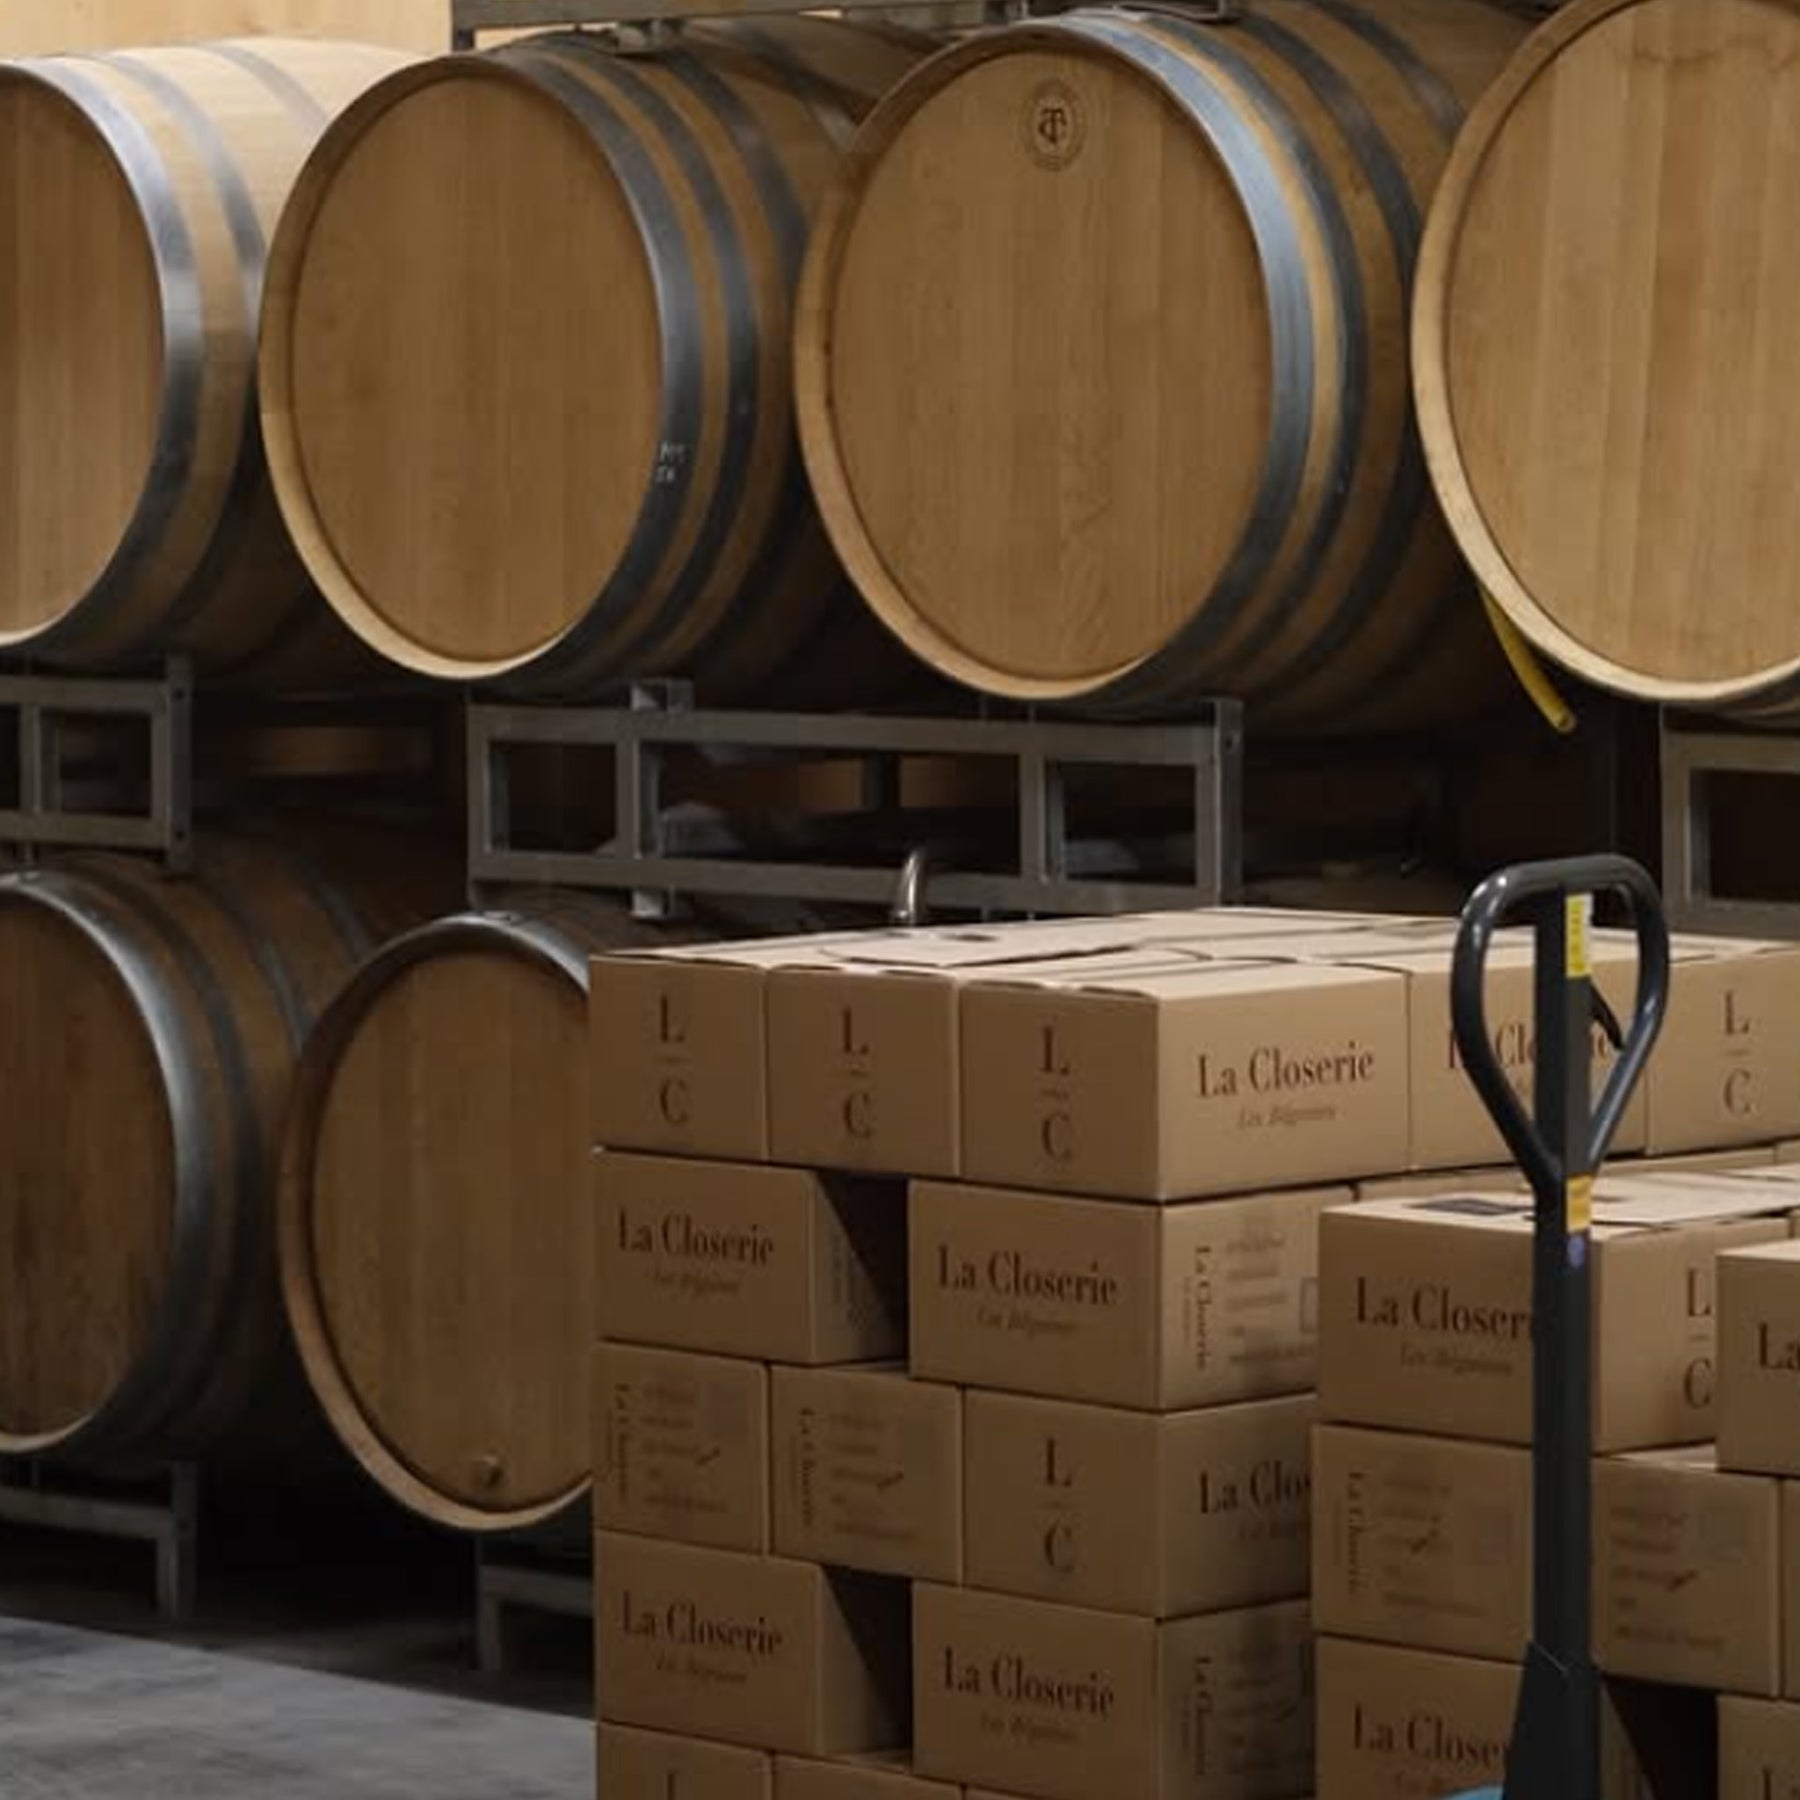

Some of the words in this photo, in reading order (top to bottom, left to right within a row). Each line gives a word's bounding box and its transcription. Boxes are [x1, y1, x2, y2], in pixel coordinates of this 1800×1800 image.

[1722, 986, 1750, 1037] L
[1197, 1052, 1239, 1099] La
[1248, 1040, 1376, 1094] Closerie
[1722, 1066, 1752, 1116] C
[617, 1203, 654, 1254] La
[660, 1210, 775, 1268] Closerie
[937, 1242, 977, 1293] La
[985, 1249, 1121, 1306] Closerie
[1355, 1274, 1399, 1328] La
[1411, 1281, 1534, 1342] Closer
[1199, 1467, 1240, 1515] La
[621, 1589, 657, 1642] La
[665, 1599, 783, 1657] Closerie
[943, 1645, 981, 1695] La
[989, 1652, 1115, 1716] Closerie
[1353, 1700, 1394, 1752] La
